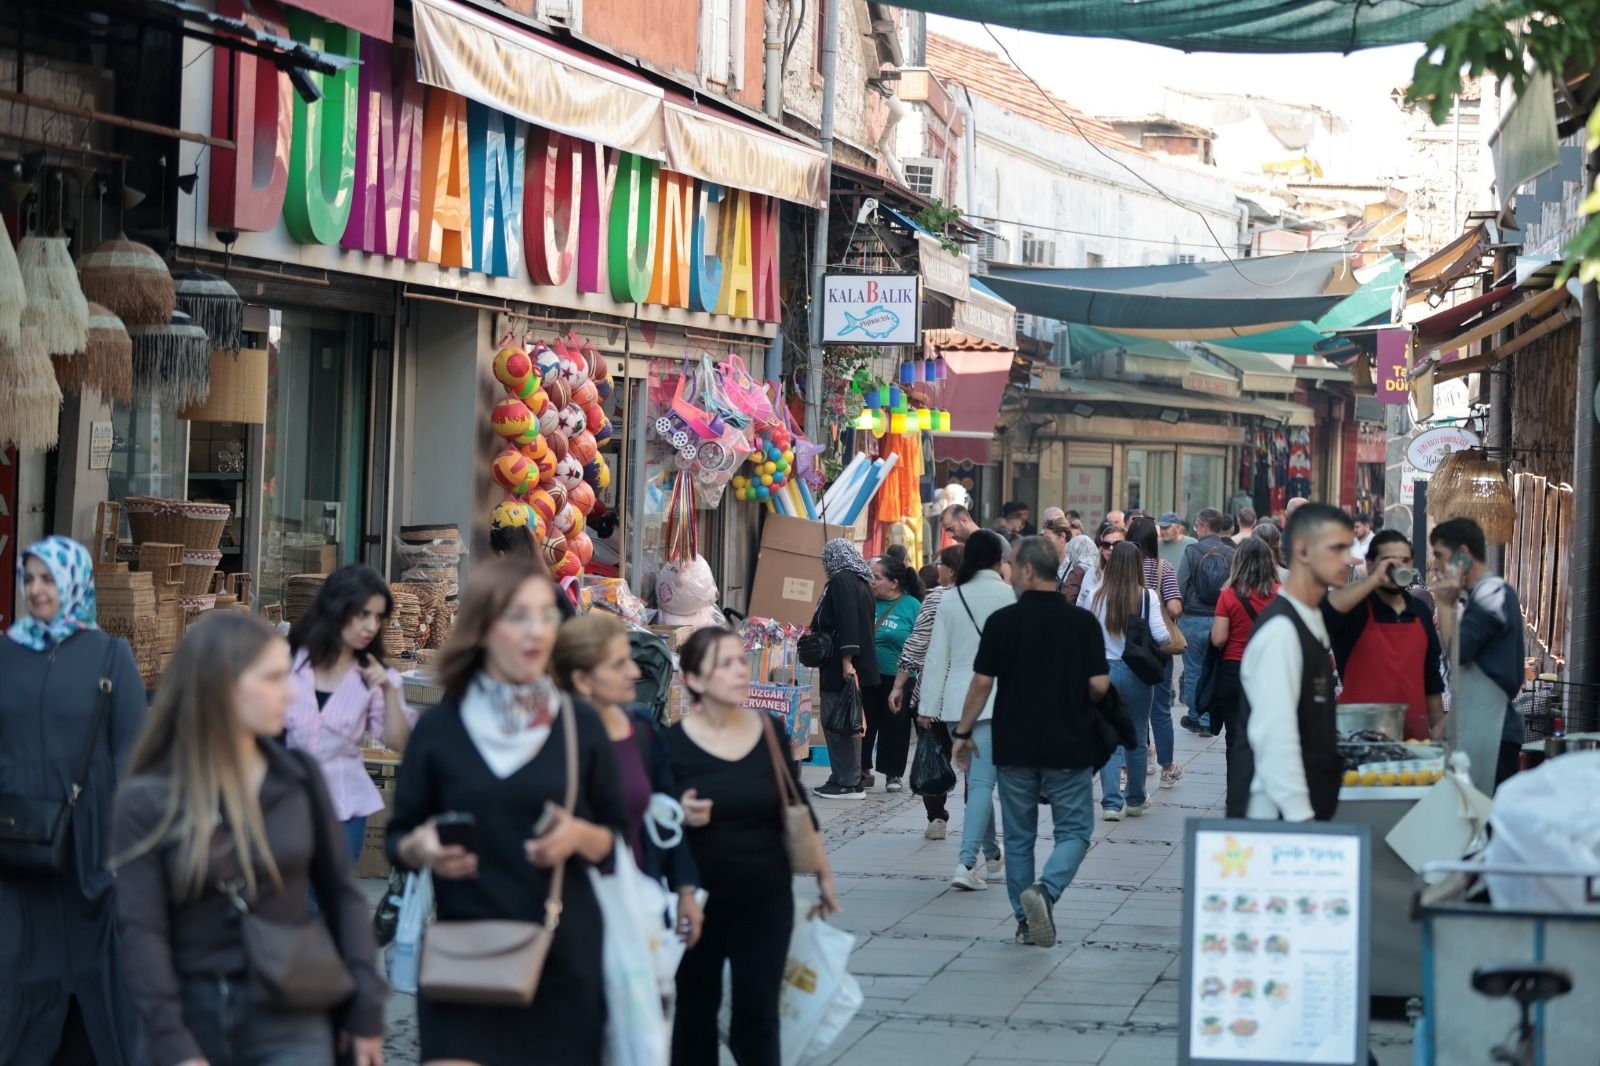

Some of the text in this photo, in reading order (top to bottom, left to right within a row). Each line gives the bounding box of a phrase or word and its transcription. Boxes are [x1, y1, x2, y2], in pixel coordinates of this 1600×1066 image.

[208, 6, 782, 324] DUMAN OYUNCAK
[828, 280, 912, 303] KALABALIK
[742, 698, 790, 712] ERVANESİ
